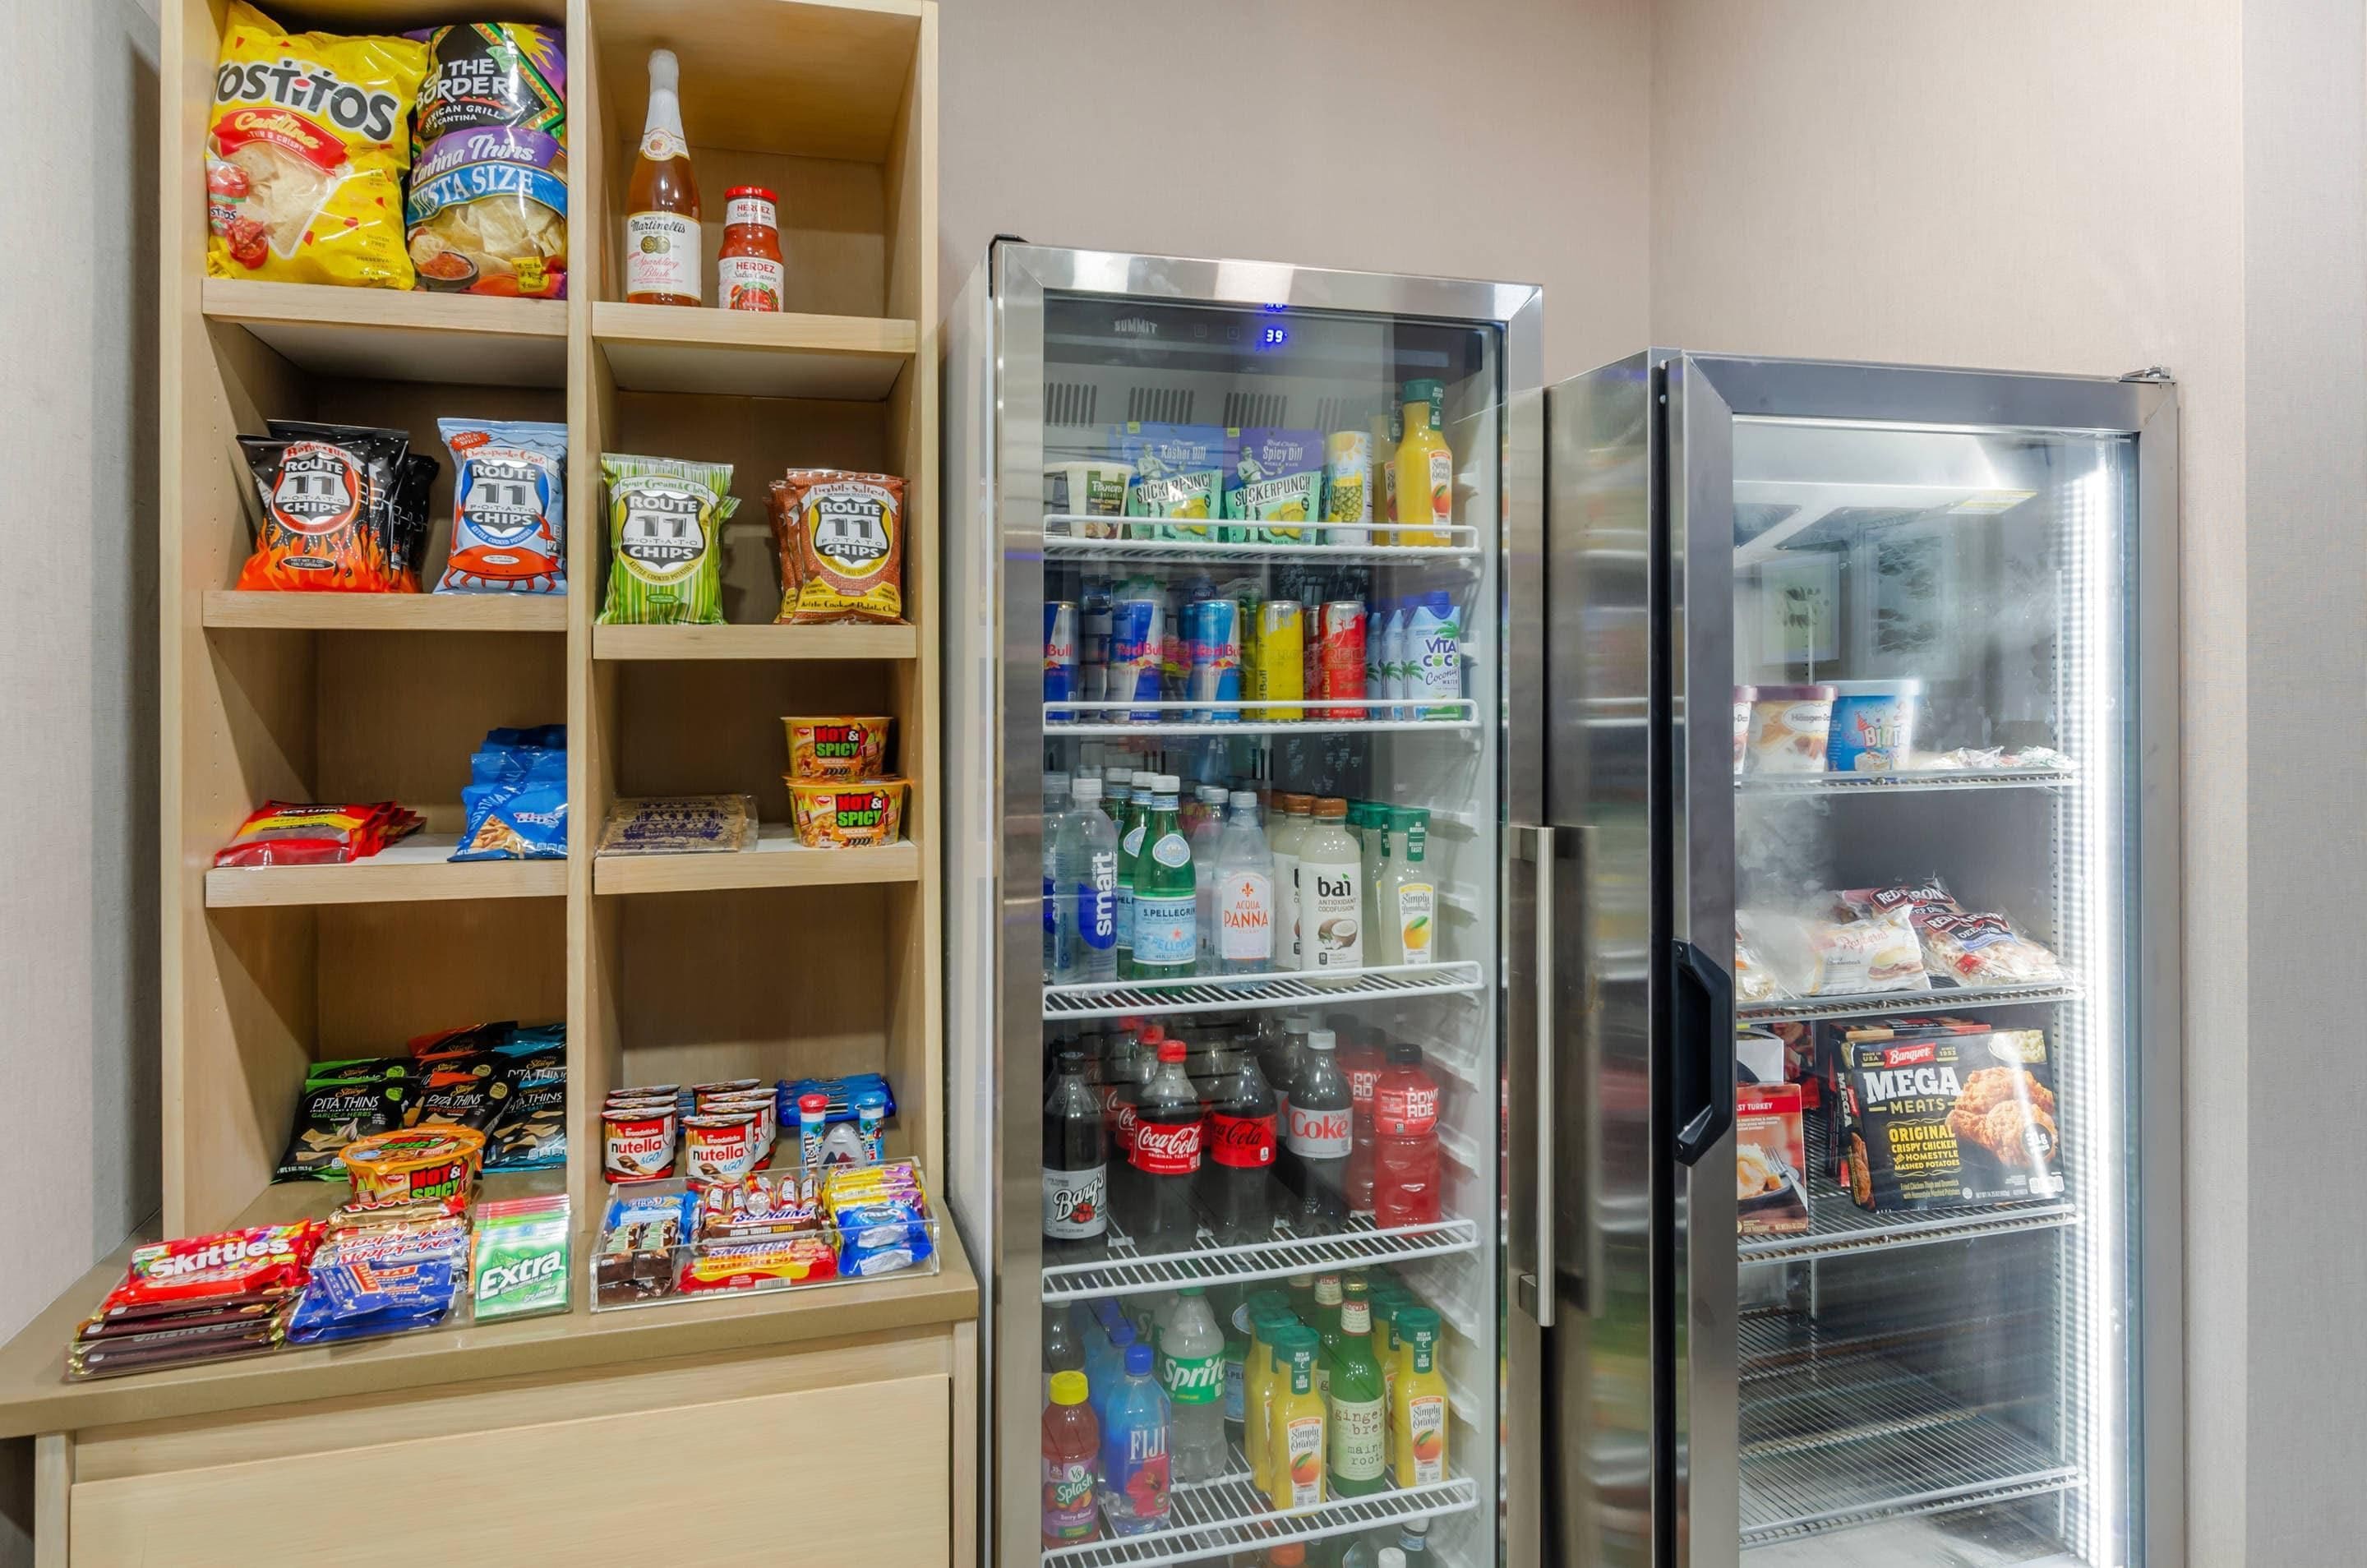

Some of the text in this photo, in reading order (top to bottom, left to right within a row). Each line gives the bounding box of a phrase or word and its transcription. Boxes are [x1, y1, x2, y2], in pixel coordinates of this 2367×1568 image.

[448, 58, 495, 76] THE
[416, 76, 518, 112] BORDER
[425, 104, 503, 132] MEXICAN GRILL
[437, 114, 478, 126] CANTINA
[235, 112, 321, 149] Cantina
[411, 133, 535, 187] Cantina Thins
[472, 164, 534, 196] SIZE
[737, 204, 771, 214] HERDEZ
[736, 261, 775, 274] HERDEZ
[1267, 329, 1284, 343] 39
[1262, 446, 1303, 462] Spicy Dill
[285, 459, 343, 474] ROUTE
[473, 464, 536, 480] ROUTE
[289, 475, 335, 496] 11
[477, 483, 526, 505] 11
[1091, 480, 1124, 494] Panera
[1234, 476, 1311, 508] SUCKERPUNCH
[283, 502, 342, 514] CHIPS
[630, 496, 698, 513] ROUTE
[820, 501, 881, 515] ROUTE
[472, 513, 533, 526] CHIPS
[634, 515, 687, 538] 11
[827, 518, 872, 539] 11
[630, 546, 694, 560] CHIPS
[824, 545, 880, 558] CHIPS
[1425, 637, 1456, 653] VITA
[814, 725, 859, 743] HOT &
[816, 742, 859, 757] SPICY
[837, 794, 883, 812] HOT &
[837, 810, 882, 828] SPICY
[1096, 851, 1113, 937] smart
[1317, 874, 1351, 897] bai
[1402, 892, 1430, 907] Simply
[1876, 888, 1902, 905] RED
[1235, 901, 1261, 910] ACQUA
[1223, 910, 1269, 928] PANNA
[1889, 1046, 1931, 1065] Banquet
[1862, 1067, 1965, 1105] MEGA
[312, 1095, 381, 1109] PITA THINS
[427, 1094, 486, 1106] PITA THINS
[528, 1091, 563, 1105] THINS
[1747, 1102, 1774, 1110] TURKEY
[1836, 1072, 1853, 1128] MEGA
[1890, 1098, 1947, 1114] MEATS
[1407, 1103, 1434, 1118] ADE
[625, 1128, 658, 1137] Breadsticks
[1290, 1111, 1350, 1140] Coke
[1889, 1124, 1956, 1143] ORIGINAL
[611, 1138, 662, 1155] nutella
[706, 1135, 741, 1145] Breadsticks
[1137, 1125, 1200, 1155] Coca-Cola
[1891, 1139, 1959, 1154] CRISPY CHICKEN
[692, 1146, 744, 1160] nutella
[1905, 1150, 1959, 1162] HOMESTYLE
[1894, 1159, 1961, 1171] MASHED POTATOES
[411, 1163, 461, 1188] HOT &
[412, 1178, 460, 1199] SPICY
[1052, 1170, 1105, 1223] Barq's
[711, 1240, 791, 1257] SNICKERS
[149, 1238, 293, 1279] Skittles
[479, 1250, 561, 1301] Extra
[1413, 1404, 1441, 1418] Simply
[1413, 1417, 1441, 1430] Orange
[1290, 1426, 1320, 1441] Simply
[1129, 1425, 1169, 1461] FIJI
[1290, 1439, 1320, 1453] Orange
[1057, 1473, 1094, 1505] Splash
